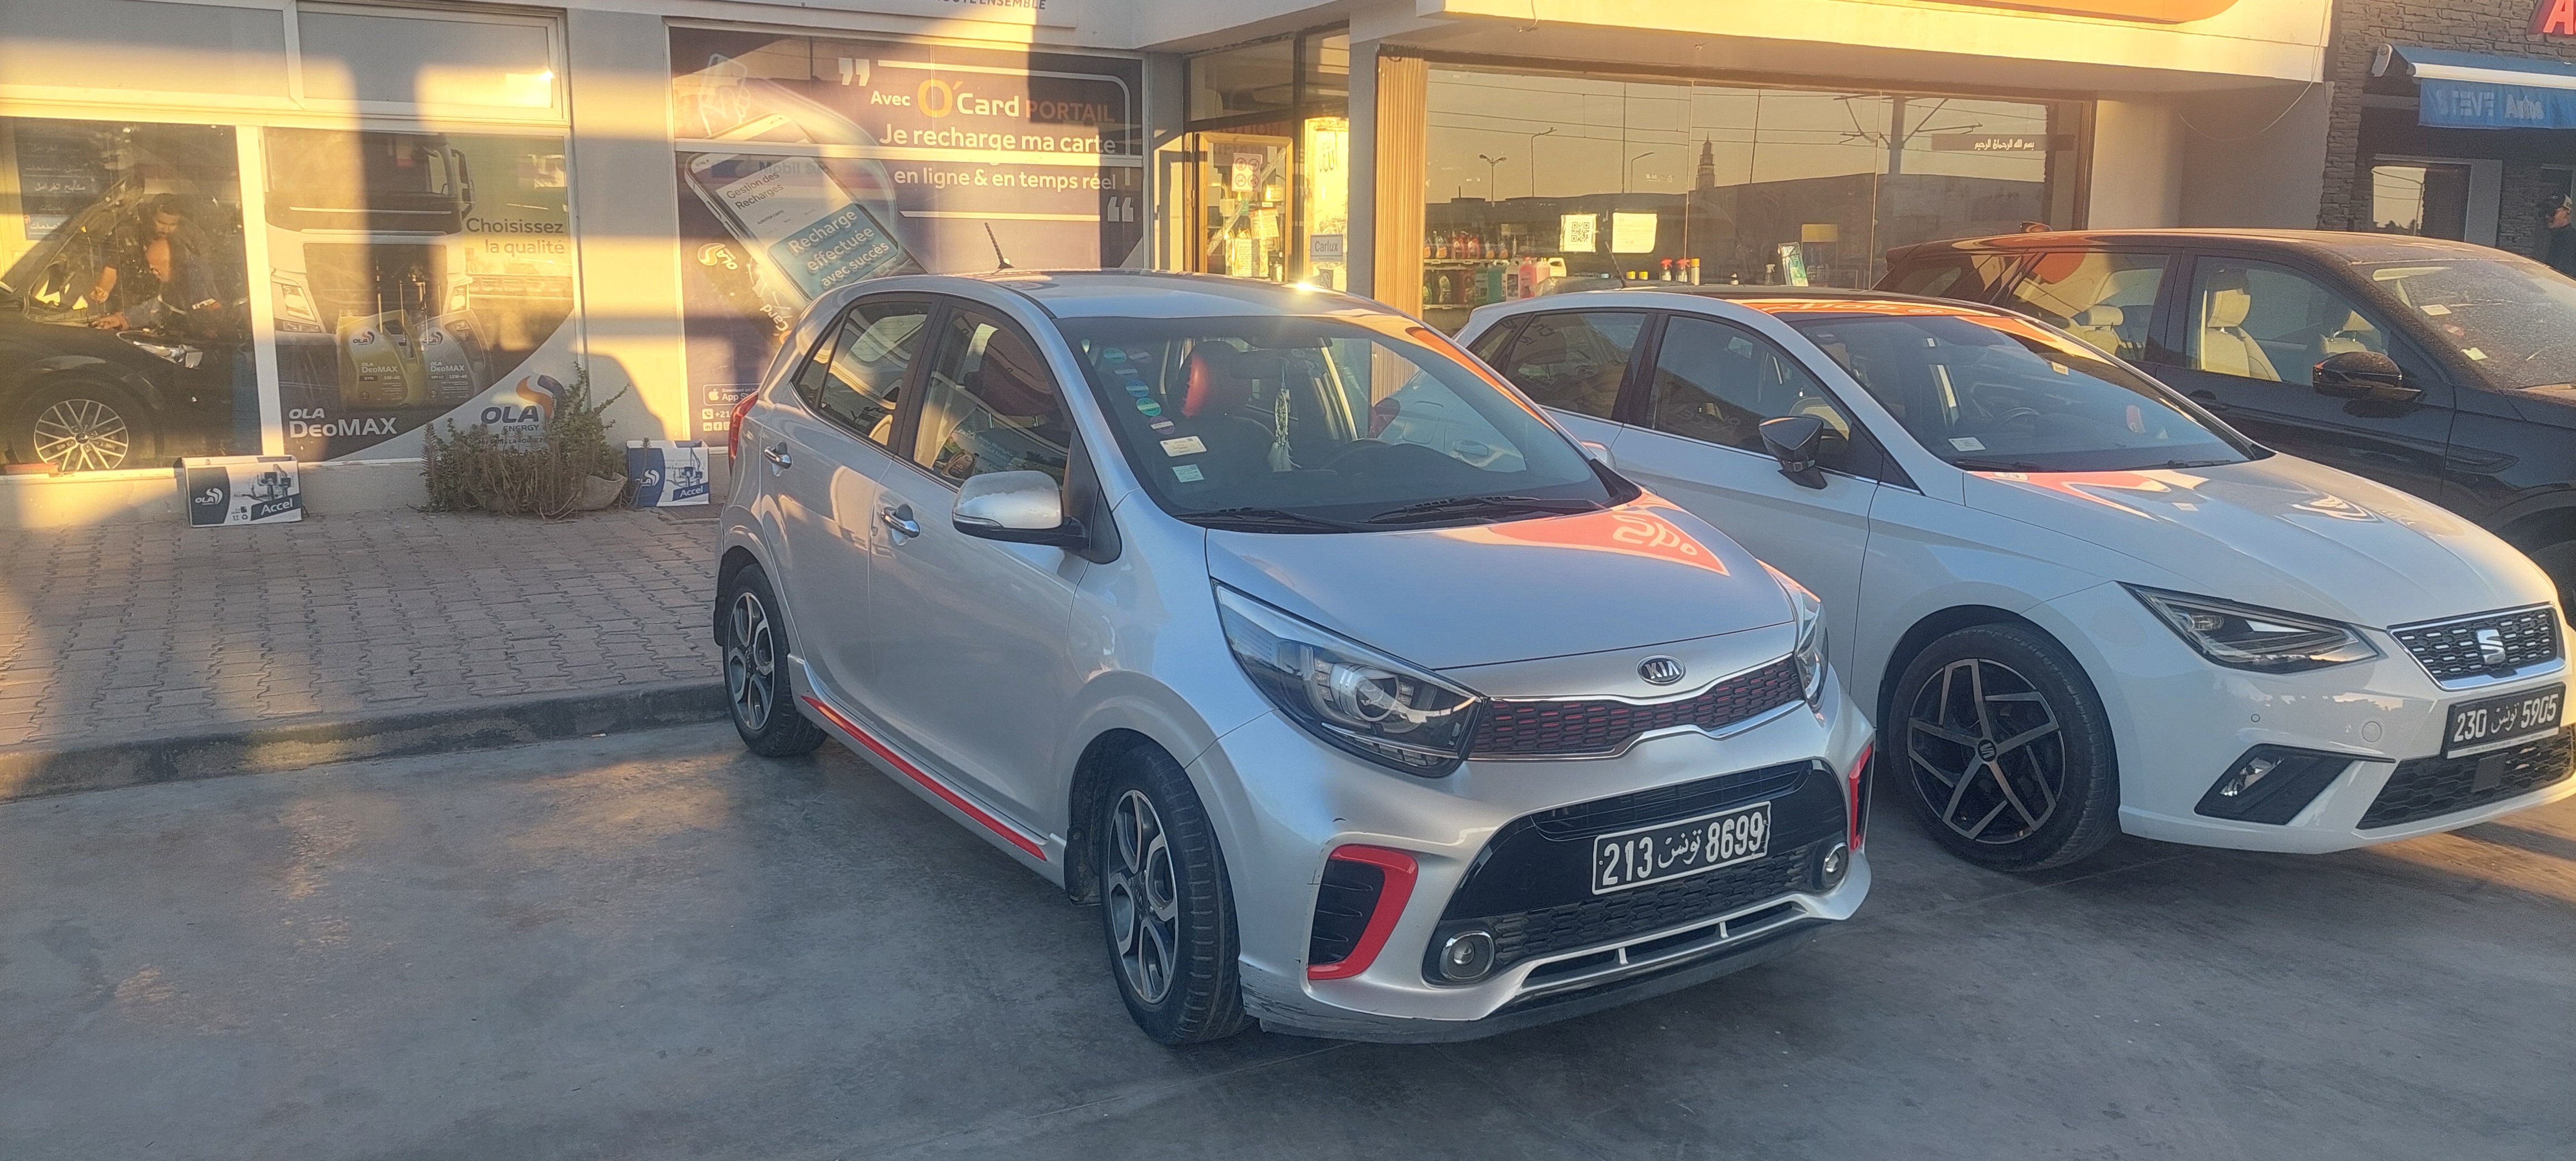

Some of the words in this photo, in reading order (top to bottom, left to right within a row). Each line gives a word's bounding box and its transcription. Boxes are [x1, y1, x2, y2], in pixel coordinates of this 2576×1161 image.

[871, 91, 911, 106] Avec
[1026, 100, 1114, 121] PORTAIL
[879, 124, 907, 145] Je
[914, 126, 1016, 152] recharge
[1022, 134, 1055, 152] ma
[1060, 134, 1116, 154] carte
[1974, 138, 1992, 150] الرحيم
[2014, 138, 2022, 148] الله
[2023, 142, 2035, 151] بسم
[726, 179, 763, 199] Gestion
[763, 172, 780, 184] des
[894, 170, 918, 184] en
[923, 168, 969, 189] ligne
[974, 169, 988, 186] &
[992, 174, 1014, 187] en
[1019, 170, 1078, 192] temps
[1082, 173, 1116, 189] réel
[735, 184, 784, 210] Recharges
[466, 218, 563, 233] Choisissez
[788, 211, 858, 255] Recharge
[485, 239, 499, 253] la
[504, 240, 565, 257] qualité
[808, 228, 875, 272] effectuée
[1315, 240, 1338, 252] Carlux
[821, 266, 851, 287] avec
[850, 242, 890, 270] succès
[721, 393, 739, 402] App
[289, 408, 325, 418] OLA
[481, 406, 539, 424] OLA
[680, 485, 703, 498] Accel
[261, 498, 293, 515] Accel
[1644, 661, 1680, 679] KIA
[2453, 709, 2487, 742] 230
[2491, 702, 2520, 734] تونس
[2521, 694, 2558, 729] 5905
[1602, 837, 1653, 886] 213
[1658, 828, 1703, 869] تونس
[1705, 812, 1766, 863] 8699
